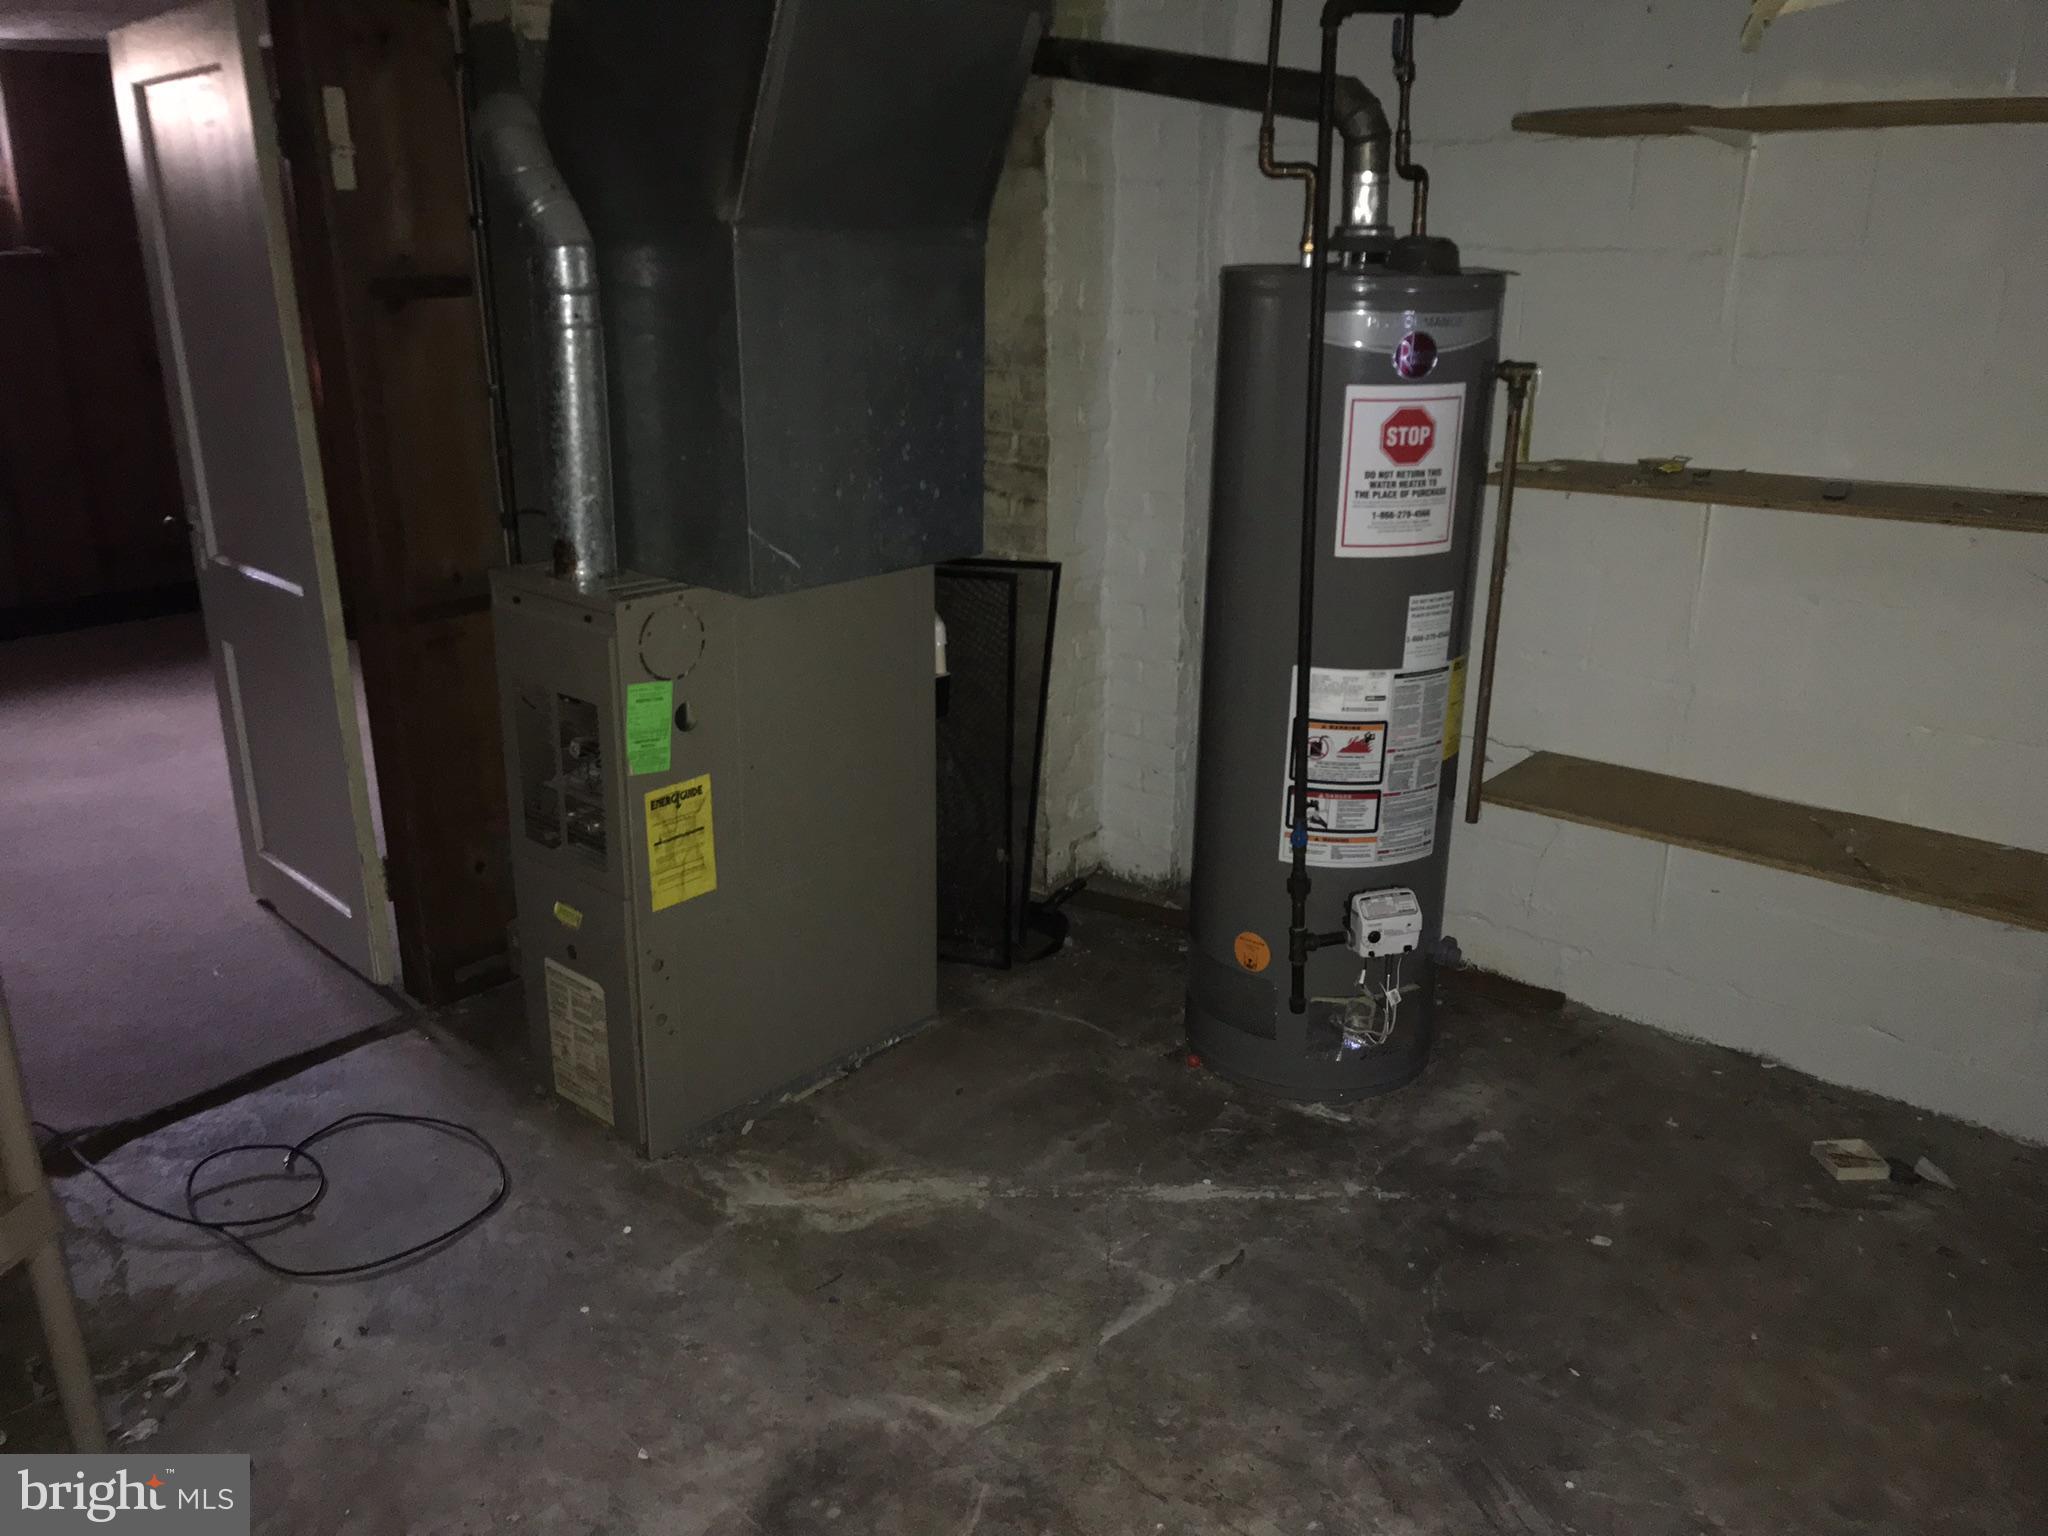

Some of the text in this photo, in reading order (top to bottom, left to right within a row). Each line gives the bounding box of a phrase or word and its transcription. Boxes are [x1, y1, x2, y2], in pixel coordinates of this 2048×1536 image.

[1386, 426, 1430, 447] STOP
[1364, 468, 1442, 479] DO NOT RETURN THIS
[1369, 478, 1437, 489] WATER HEATER TO
[1355, 487, 1447, 499] THE PLACE OF PURCHASE
